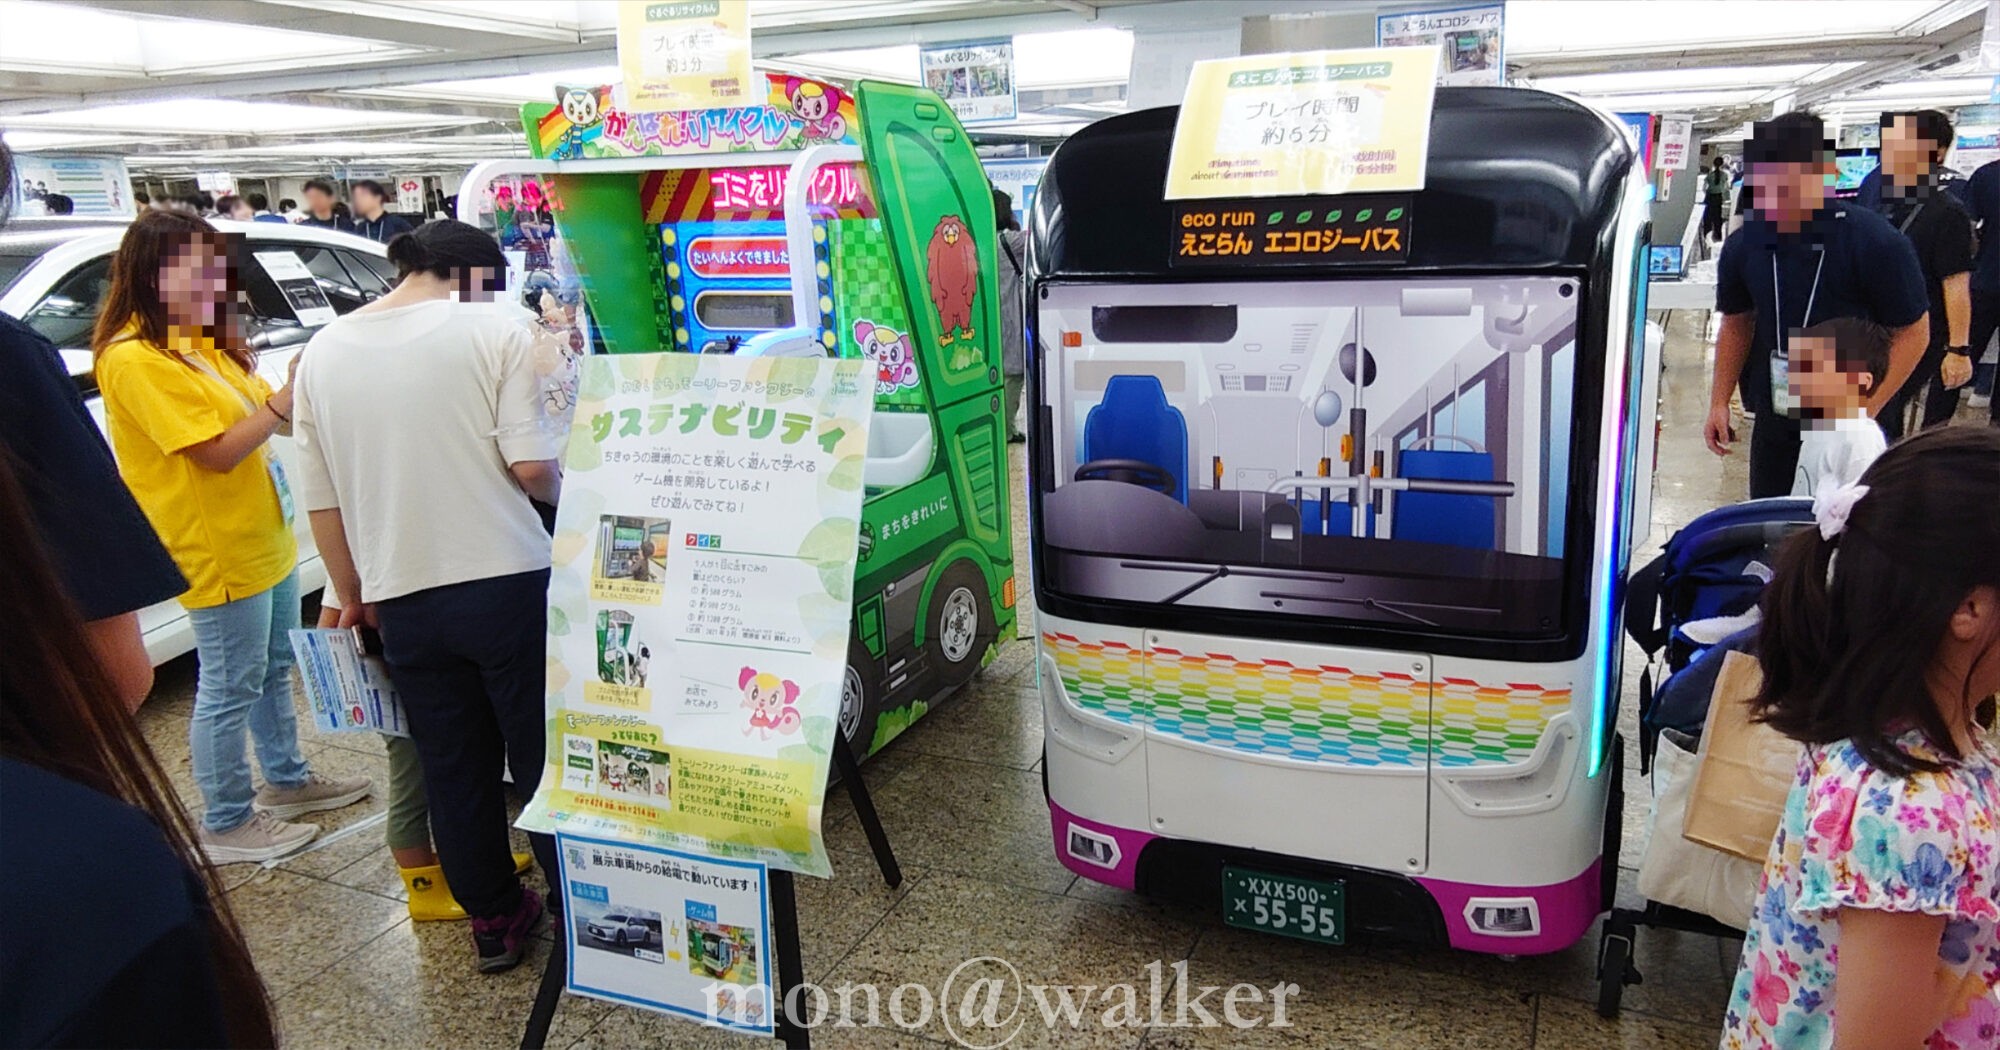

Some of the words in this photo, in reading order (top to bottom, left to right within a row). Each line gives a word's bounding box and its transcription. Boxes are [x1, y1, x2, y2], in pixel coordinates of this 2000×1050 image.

[1246, 95, 1360, 121] プレイ時間
[710, 166, 858, 208] ゴミをリイクル
[1181, 213, 1216, 227] eco
[1222, 211, 1255, 226] run
[1180, 232, 1254, 256] えこらん
[1263, 228, 1401, 253] エコロジーバス
[590, 400, 847, 455] サステナビリティ
[604, 450, 817, 473] ちきゅうの環境のことを楽しく遊んで学べる
[881, 496, 949, 541] まちをきれいに
[686, 533, 721, 548] クイズ
[592, 854, 758, 893] 展示車両からの給電で動いています！
[1253, 895, 1336, 937] 55-55
